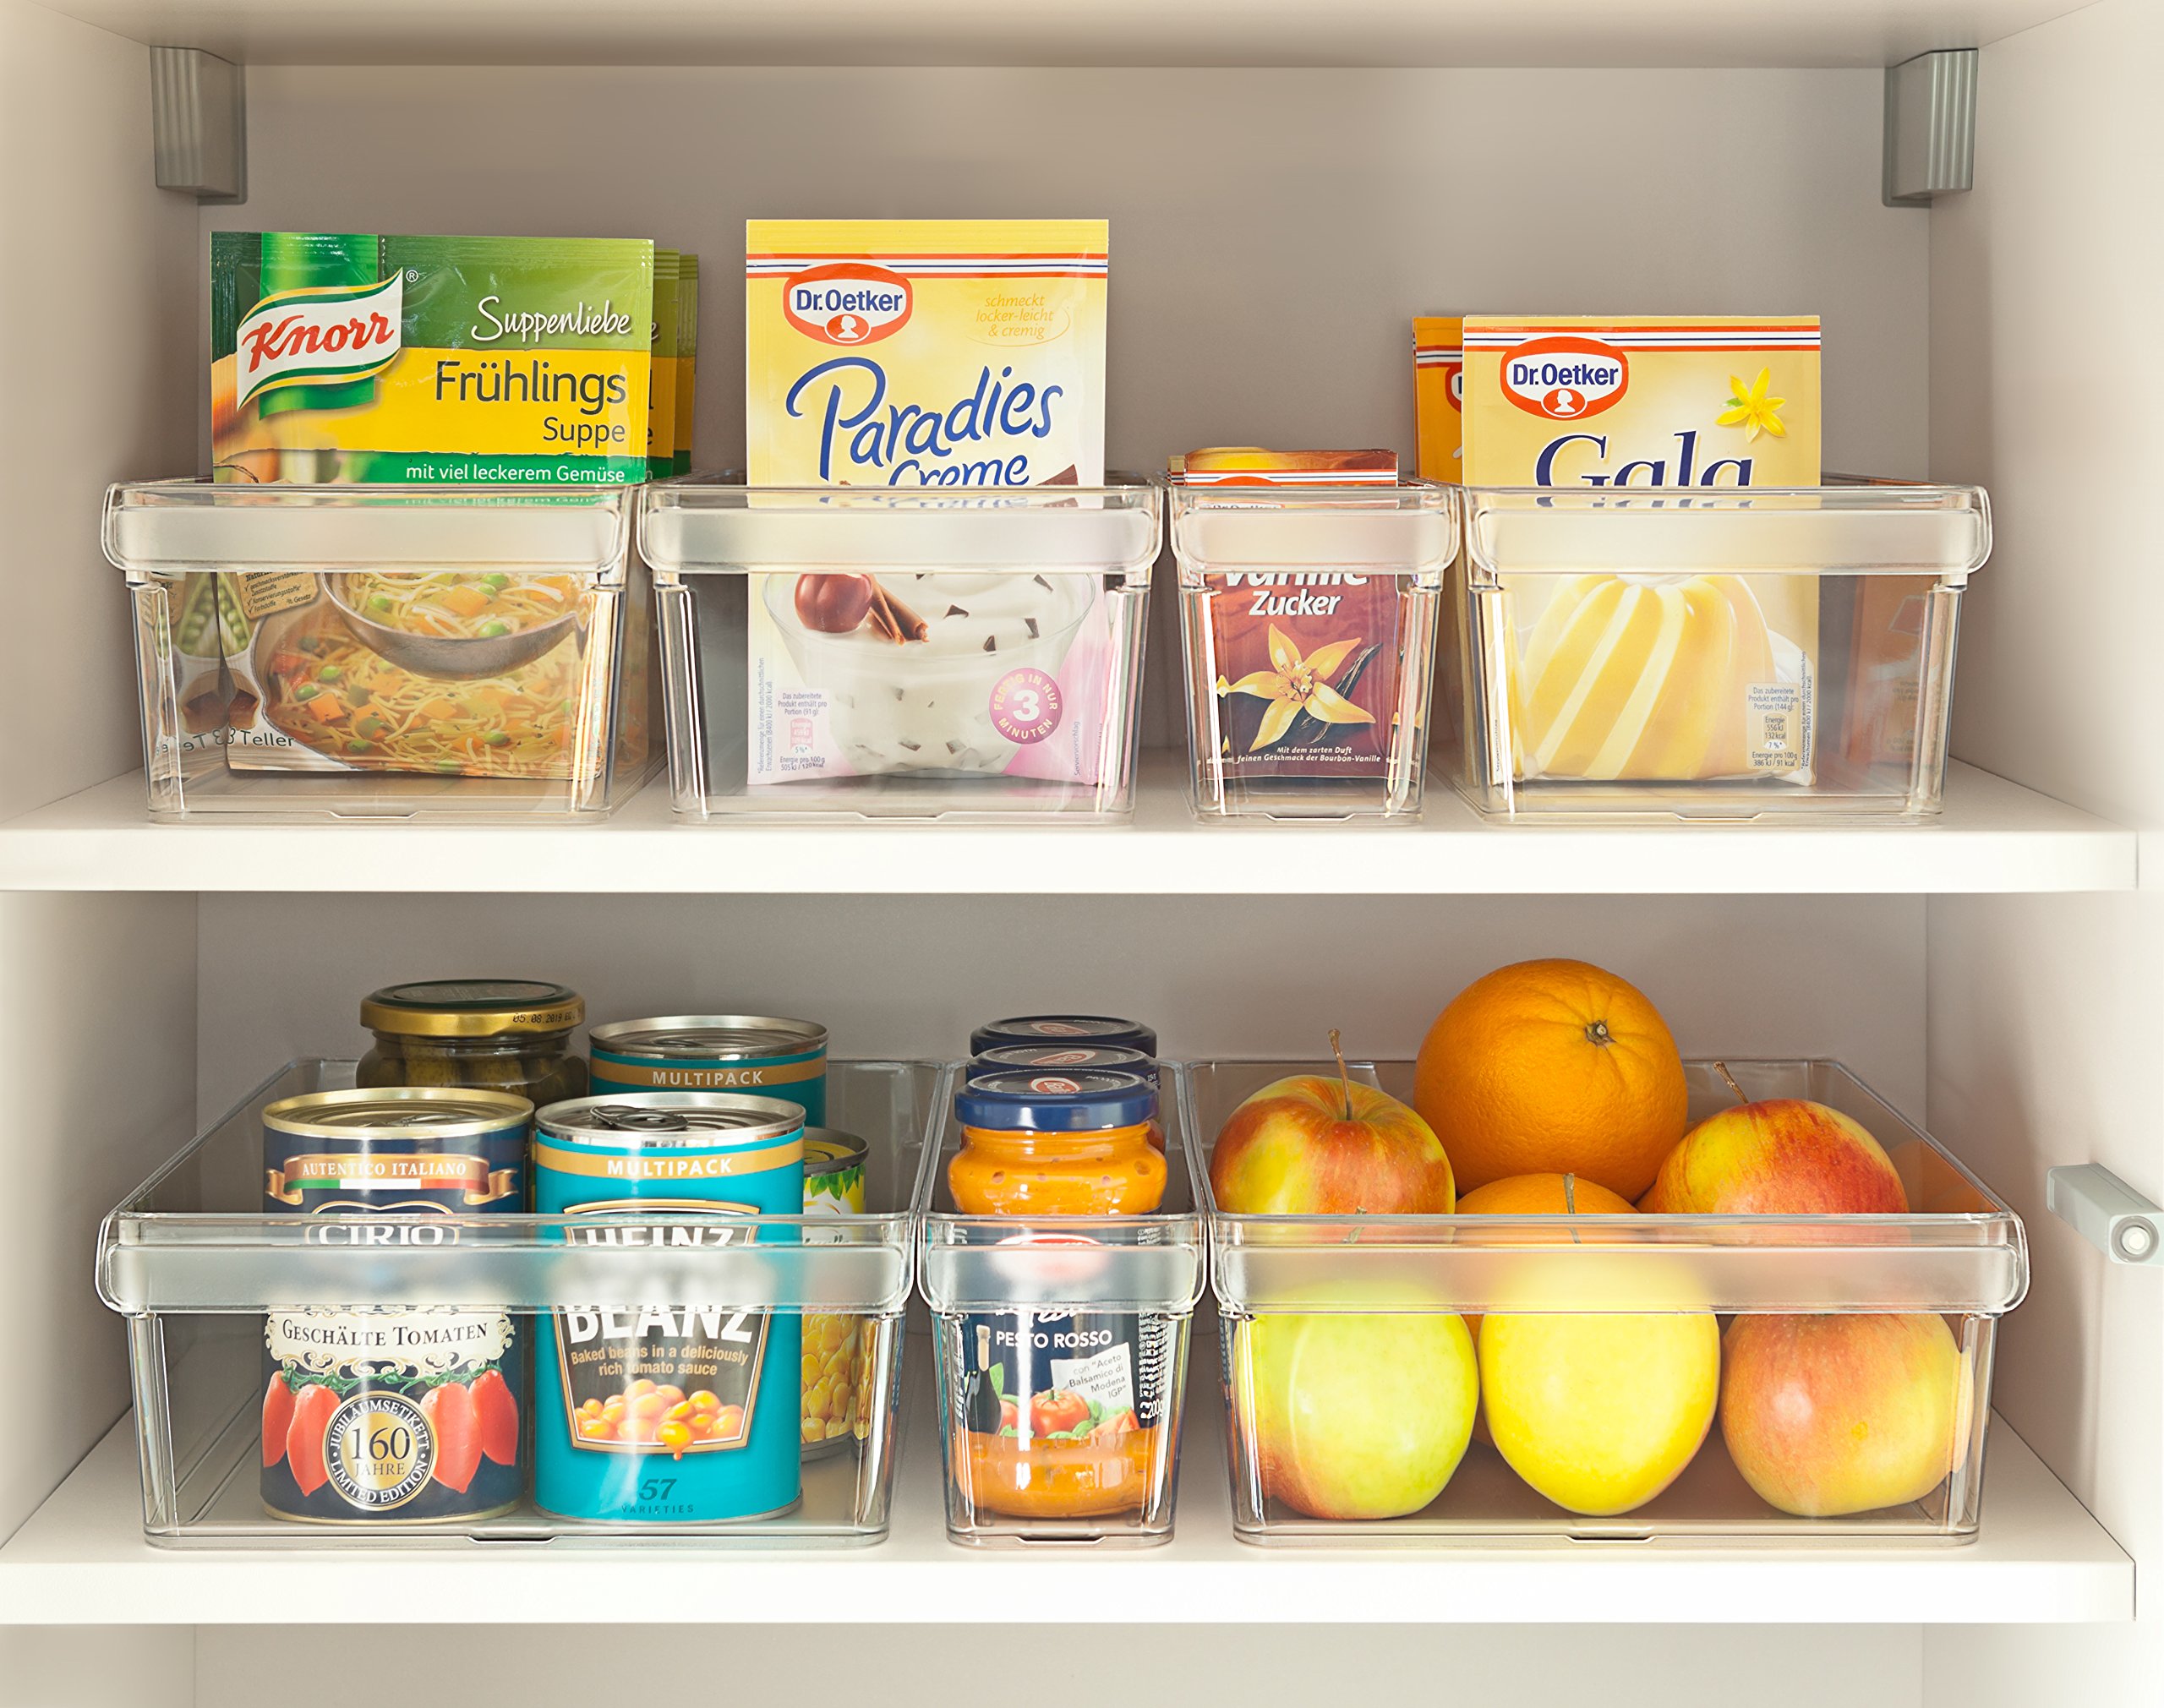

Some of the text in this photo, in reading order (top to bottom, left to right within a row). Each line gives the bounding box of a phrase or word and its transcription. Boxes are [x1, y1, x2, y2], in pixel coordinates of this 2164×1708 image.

[796, 289, 903, 312] Dr.Oetker
[985, 293, 1045, 308] schmeckt
[471, 296, 631, 341] Suppenliebe
[975, 308, 1054, 324] locker-leicht
[988, 323, 1045, 340] & cremig
[242, 313, 394, 373] Knorr
[1513, 363, 1618, 387] Dr.Oetker
[436, 360, 626, 414] Frühlings
[785, 357, 1063, 482] Paradies
[544, 417, 626, 448] Suppe
[1536, 431, 1753, 487] Gala
[406, 464, 434, 478] mit
[440, 464, 468, 480] viel
[473, 464, 551, 481] leckerem
[557, 466, 626, 483] Gemüse
[1249, 588, 1341, 616] Zucker
[1028, 674, 1042, 685] IN
[1042, 684, 1057, 710] NUR
[1013, 690, 1040, 722] 3
[227, 728, 294, 747] 3 Teller
[999, 718, 1052, 739] MINUTEN
[1237, 755, 1261, 764] feinen
[1320, 754, 1380, 762] Bourbon-Vanille
[652, 1070, 763, 1086] MULTIPACK
[303, 1162, 466, 1176] AUTENTICO ITALIANO
[608, 1158, 733, 1176] MULTIPACK
[319, 1225, 444, 1245] CIRIO
[566, 1305, 752, 1344] BEANZ
[1054, 1330, 1112, 1348] ROSSO
[571, 1345, 749, 1367] Baked beans in a deliciously
[598, 1361, 718, 1376] rich tomato sauce
[1069, 1363, 1123, 1388] Balsamico di
[1074, 1366, 1090, 1375] con
[1090, 1376, 1125, 1394] Modena
[330, 1400, 429, 1449] JUBILÄUMSETIKETT
[351, 1427, 410, 1460] 160
[355, 1463, 406, 1477] JAHRE
[331, 1460, 428, 1503] LIMITED EDITION
[638, 1478, 677, 1500] 57
[621, 1503, 694, 1514] VARIETIES
